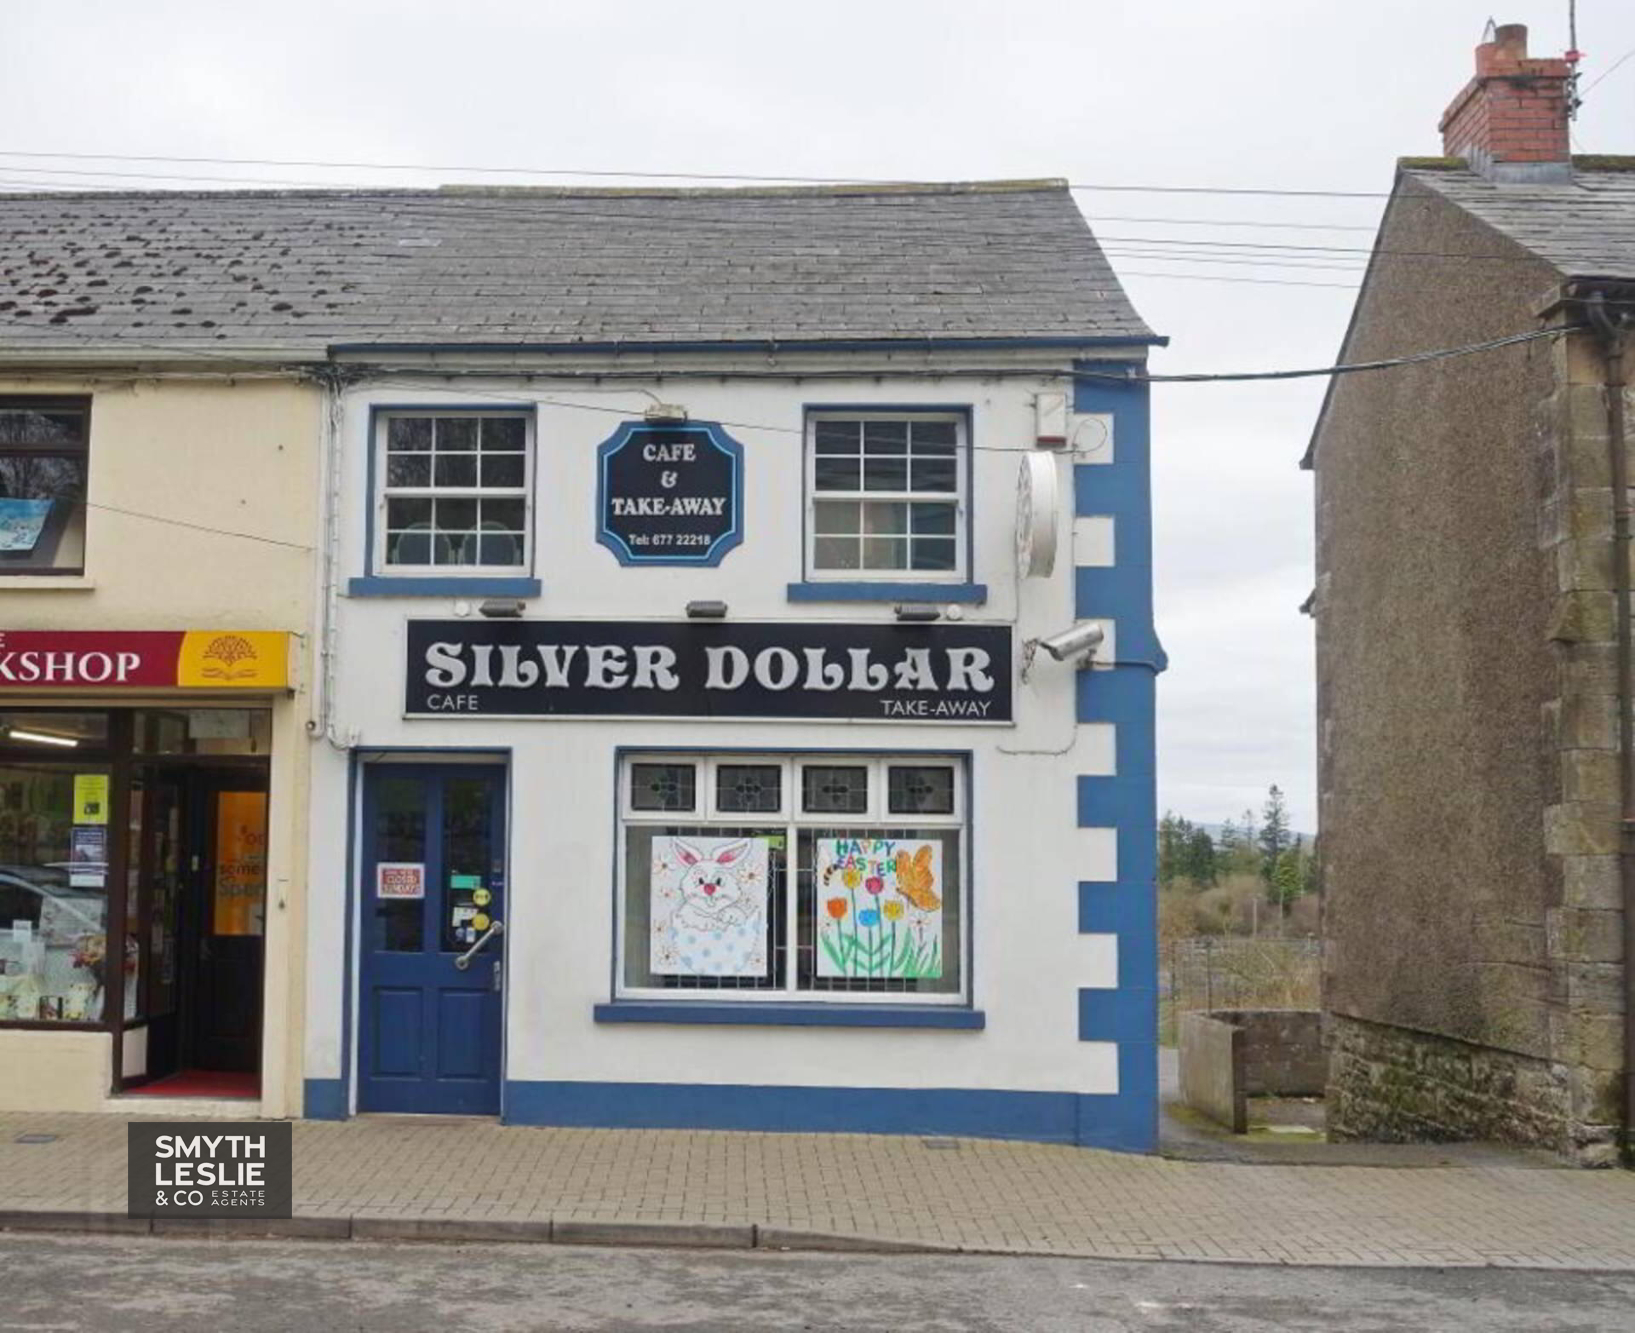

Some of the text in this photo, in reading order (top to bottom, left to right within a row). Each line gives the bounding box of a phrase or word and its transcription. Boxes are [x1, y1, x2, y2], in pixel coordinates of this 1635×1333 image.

[643, 444, 697, 462] CAFE
[661, 471, 678, 488] &
[612, 497, 726, 516] TAKE-AWAY
[628, 533, 711, 546] Tel: 677 22218
[0, 651, 141, 682] KSHOP
[425, 642, 995, 692] SILVER DOLLAR
[427, 694, 479, 710] CAFE
[880, 700, 992, 717] TAKE-AWAY
[836, 839, 896, 856] HAPPY
[836, 853, 897, 876] EASTER
